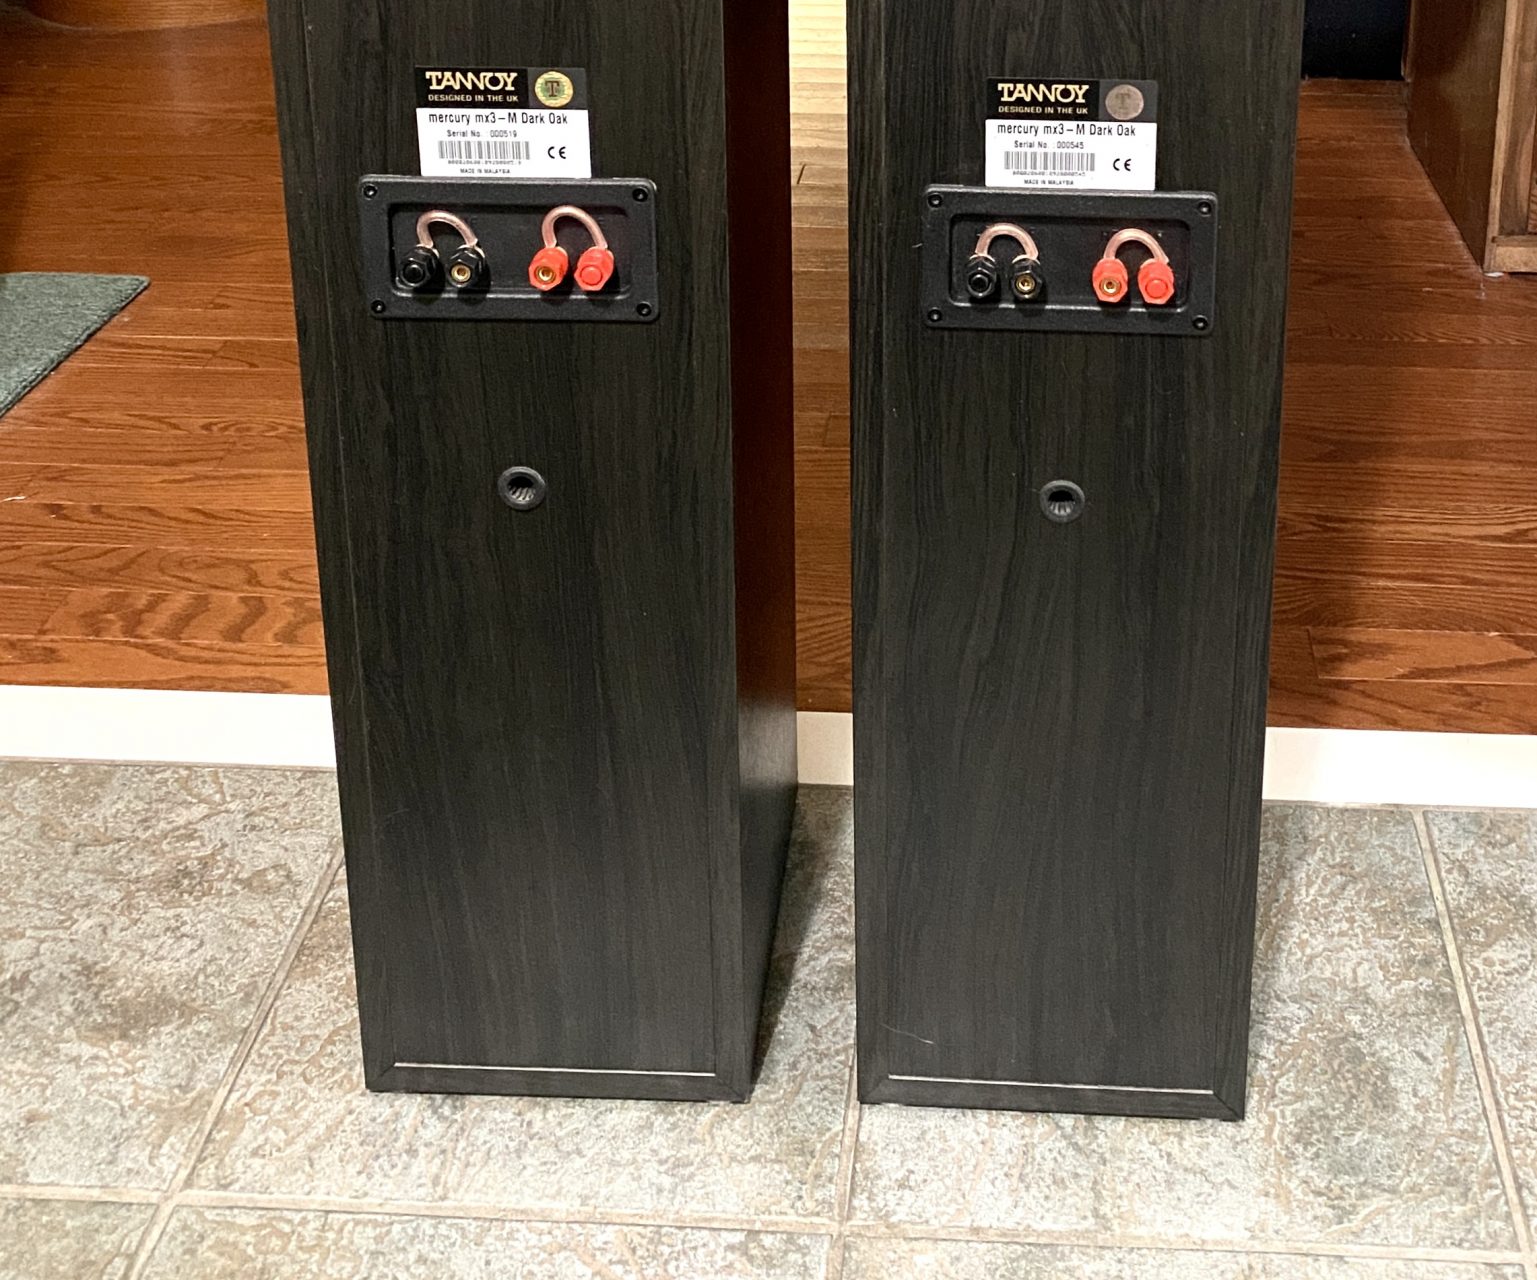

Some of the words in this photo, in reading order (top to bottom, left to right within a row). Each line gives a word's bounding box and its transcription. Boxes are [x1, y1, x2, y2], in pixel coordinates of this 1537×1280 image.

[425, 71, 518, 91] TANNOY
[428, 94, 472, 102] DESIGNED
[475, 94, 484, 102] IN
[506, 95, 519, 103] UK
[997, 83, 1090, 103] TANNOY
[998, 105, 1042, 113] DESIGNED
[1044, 106, 1054, 114] IN
[1076, 107, 1088, 115] UK
[428, 113, 471, 125] mercury
[521, 112, 545, 124] Dark
[549, 112, 568, 125] Oak
[446, 129, 468, 138] Serial
[997, 124, 1039, 136] mercury
[1089, 124, 1113, 136] Dark
[1117, 124, 1136, 136] Oak
[1014, 140, 1035, 148] Serial
